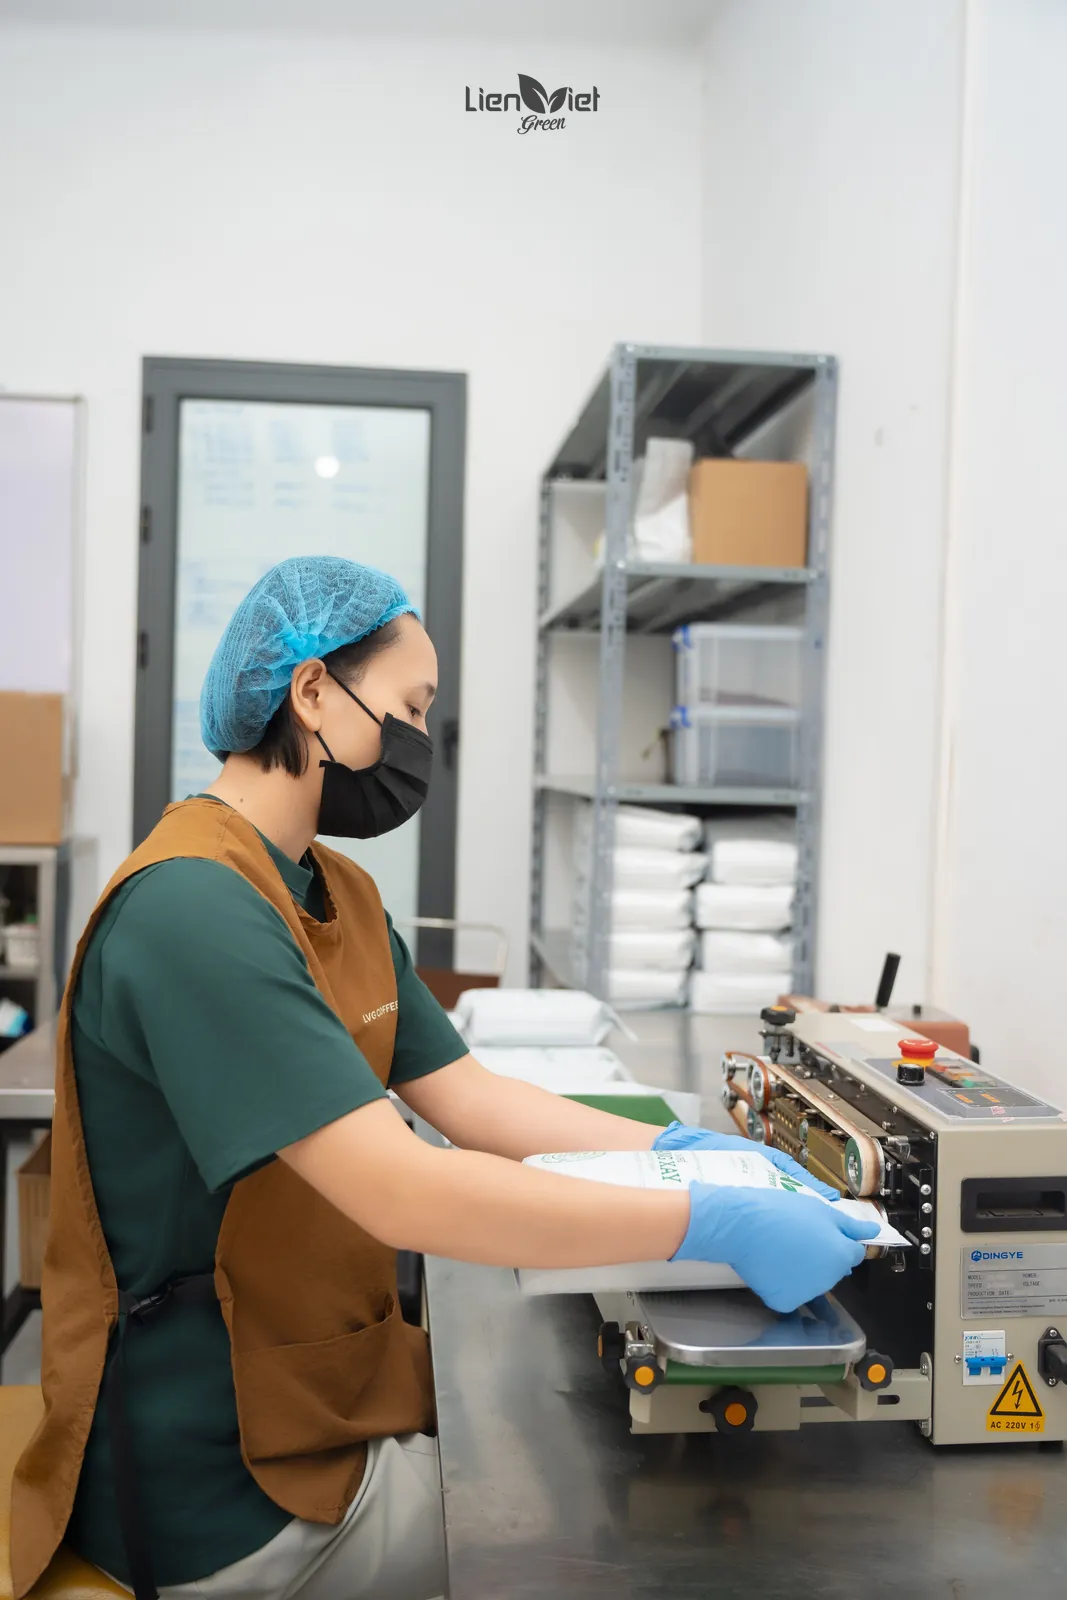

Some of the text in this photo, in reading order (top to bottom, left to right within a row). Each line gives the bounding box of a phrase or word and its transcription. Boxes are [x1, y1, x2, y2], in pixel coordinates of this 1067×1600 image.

[982, 1251, 1024, 1260] DINGYE
[990, 1421, 1002, 1429] AC
[1005, 1421, 1027, 1430] 220V
